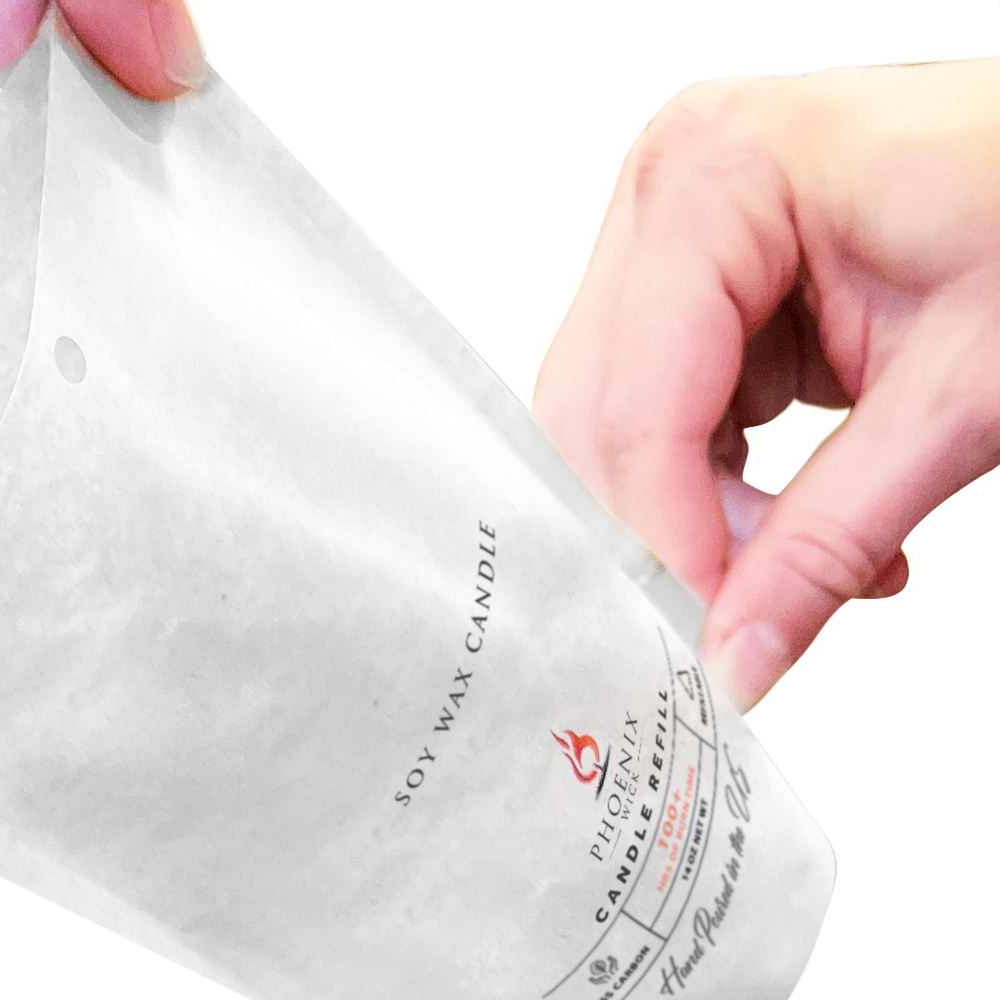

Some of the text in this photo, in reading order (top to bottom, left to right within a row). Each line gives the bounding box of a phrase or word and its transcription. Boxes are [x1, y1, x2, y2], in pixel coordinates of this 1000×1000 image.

[394, 520, 497, 807] SOY WAX CANDLE
[590, 711, 638, 862] PHOENIX
[595, 690, 668, 924] CANDLE REFILL
[620, 771, 640, 821] WICK
[656, 788, 682, 850] 100+
[612, 945, 651, 990] CARBON
[660, 936, 705, 996] Hand
